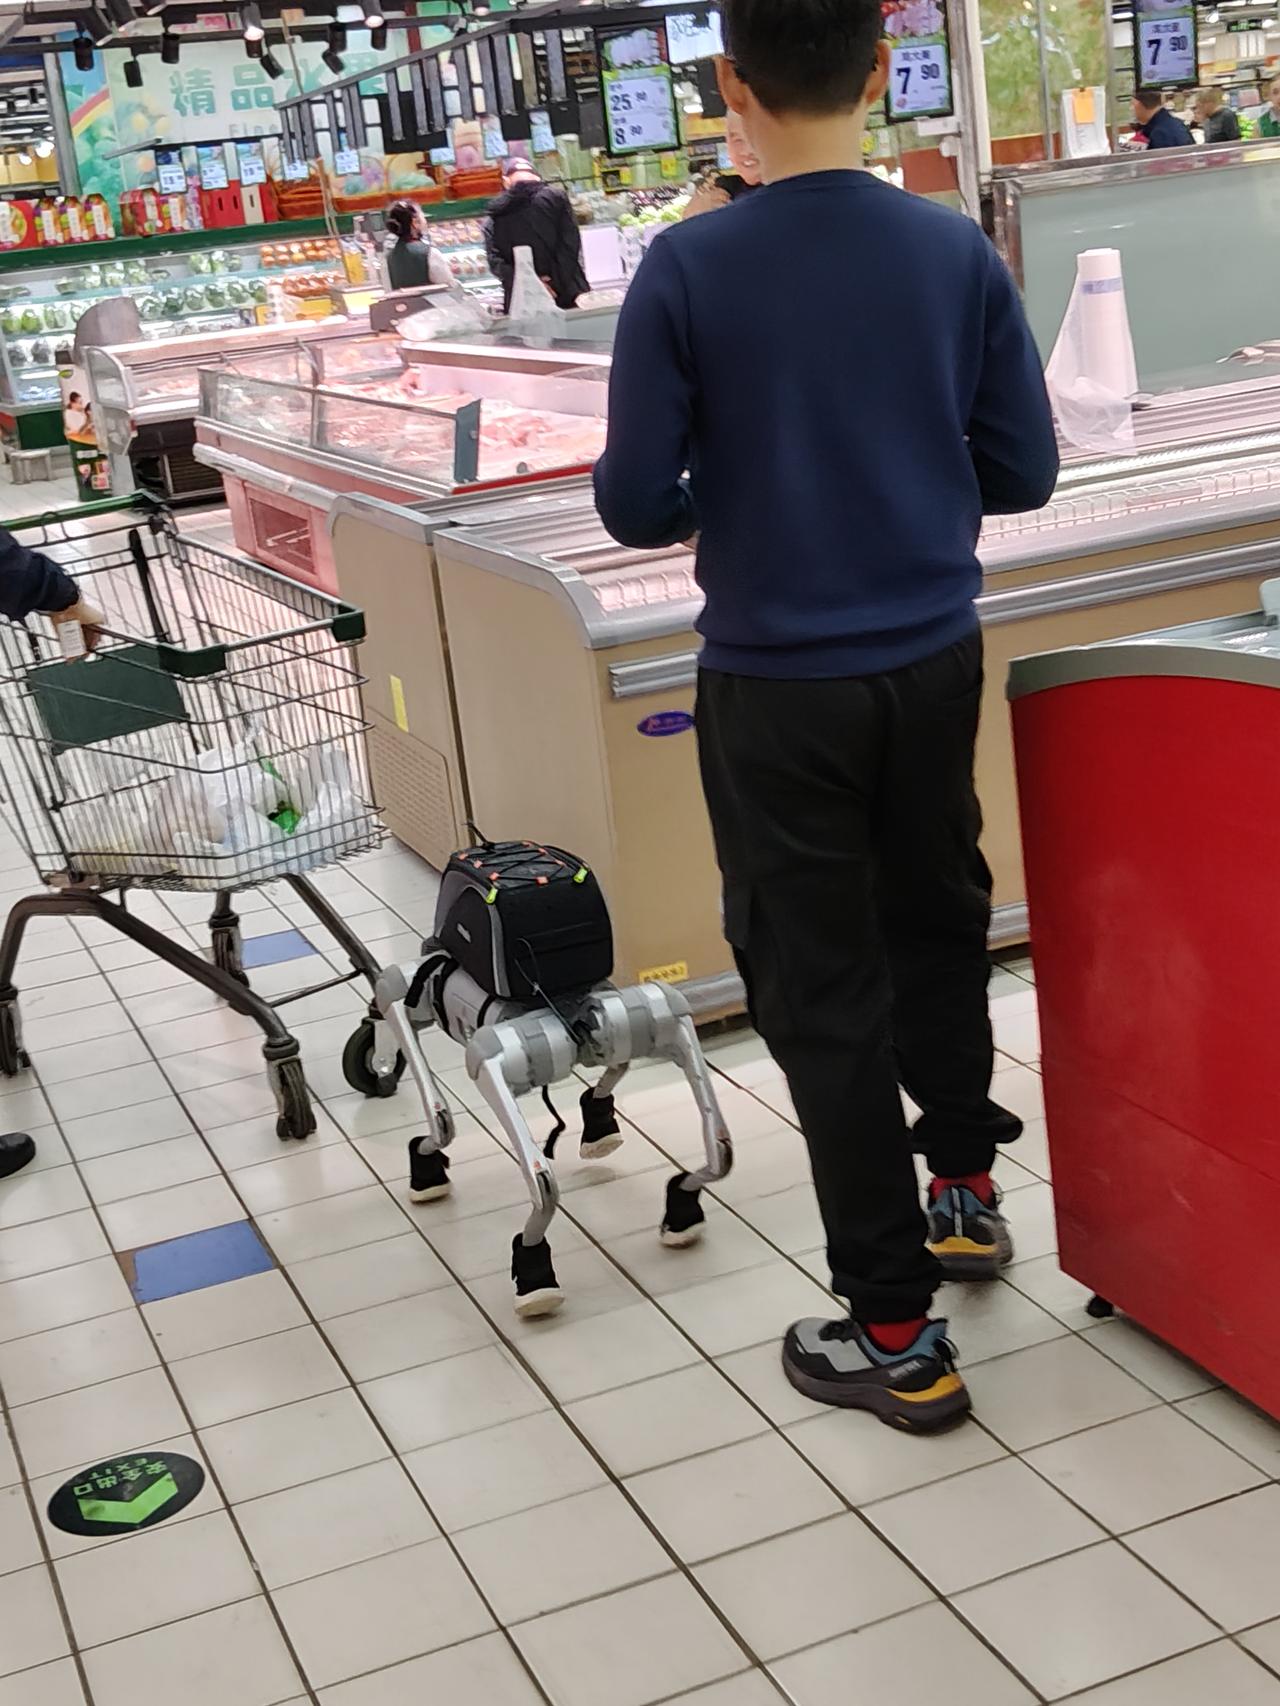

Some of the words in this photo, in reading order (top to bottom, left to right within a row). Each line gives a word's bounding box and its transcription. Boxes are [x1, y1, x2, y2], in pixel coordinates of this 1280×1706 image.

[1147, 38, 1162, 65] 7
[1169, 35, 1189, 51] 90
[896, 66, 911, 94] 7
[921, 63, 940, 80] 90
[609, 93, 632, 111] 25
[615, 127, 626, 145] 8
[73, 1460, 168, 1496] 安全出口
[88, 1457, 148, 1480] EXIT
